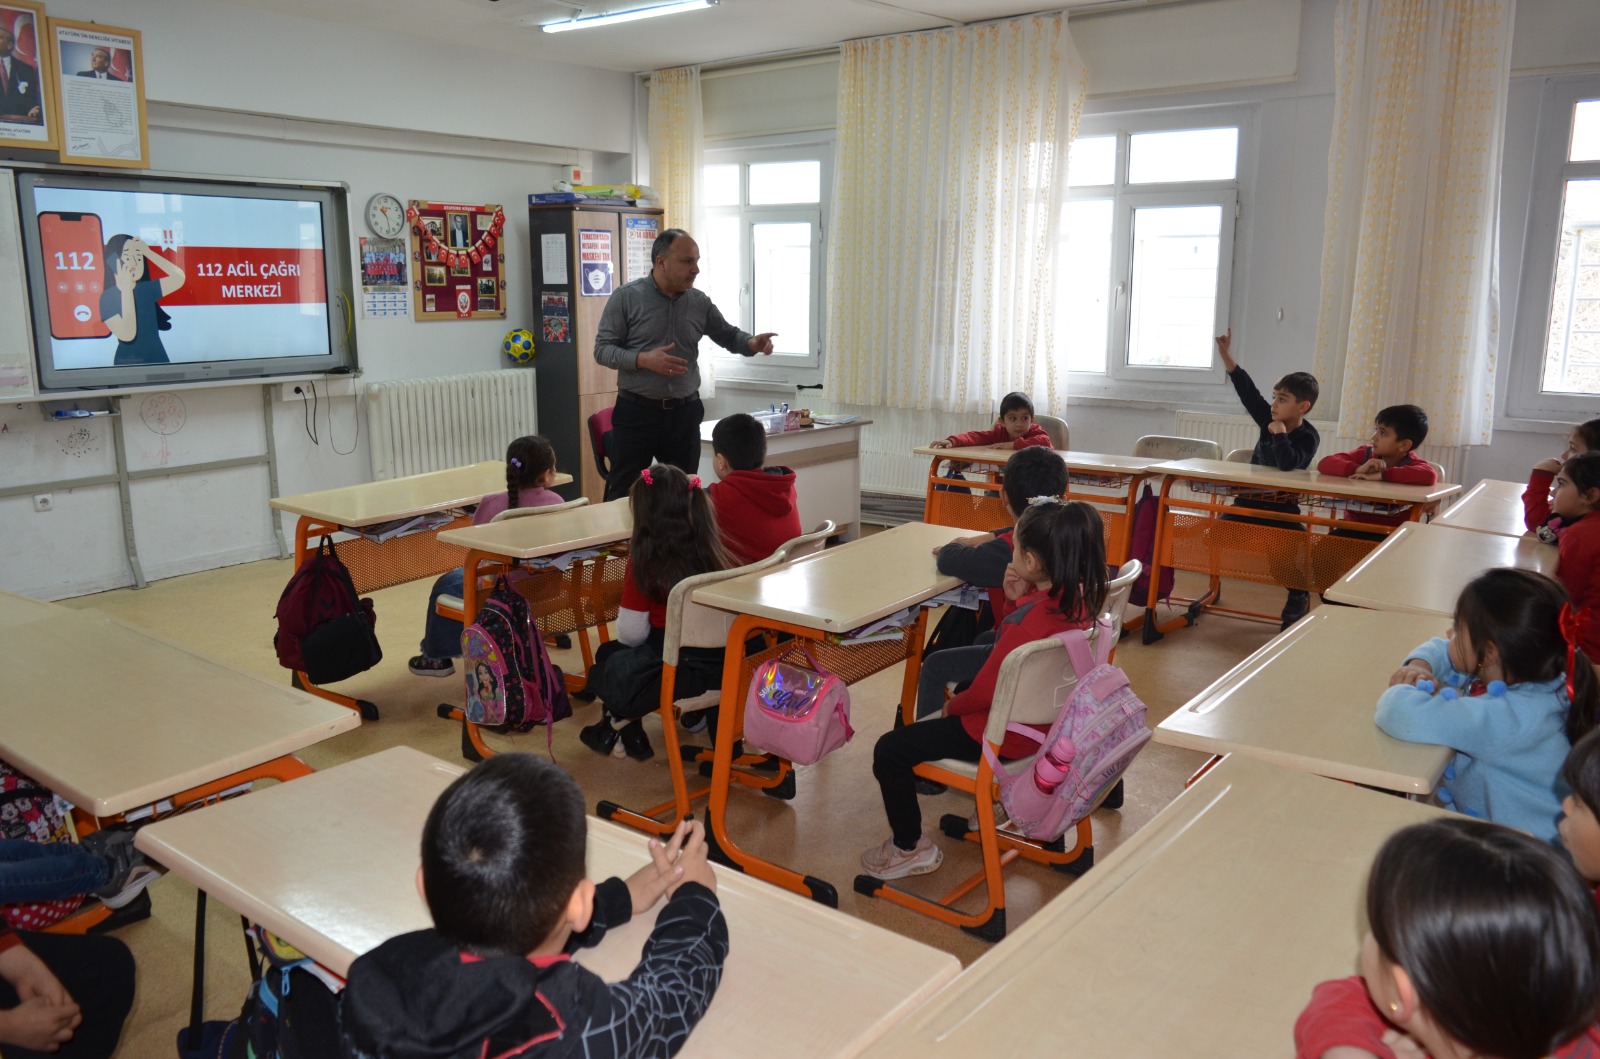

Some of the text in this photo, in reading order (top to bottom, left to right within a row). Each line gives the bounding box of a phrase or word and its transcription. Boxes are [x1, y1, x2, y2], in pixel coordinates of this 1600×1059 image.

[54, 251, 95, 270] 112
[197, 260, 300, 279] 112 ACİL ÇAĞRI
[221, 282, 281, 298] MERKEZİ
[758, 682, 781, 698] SUPER
[772, 689, 811, 711] Girl
